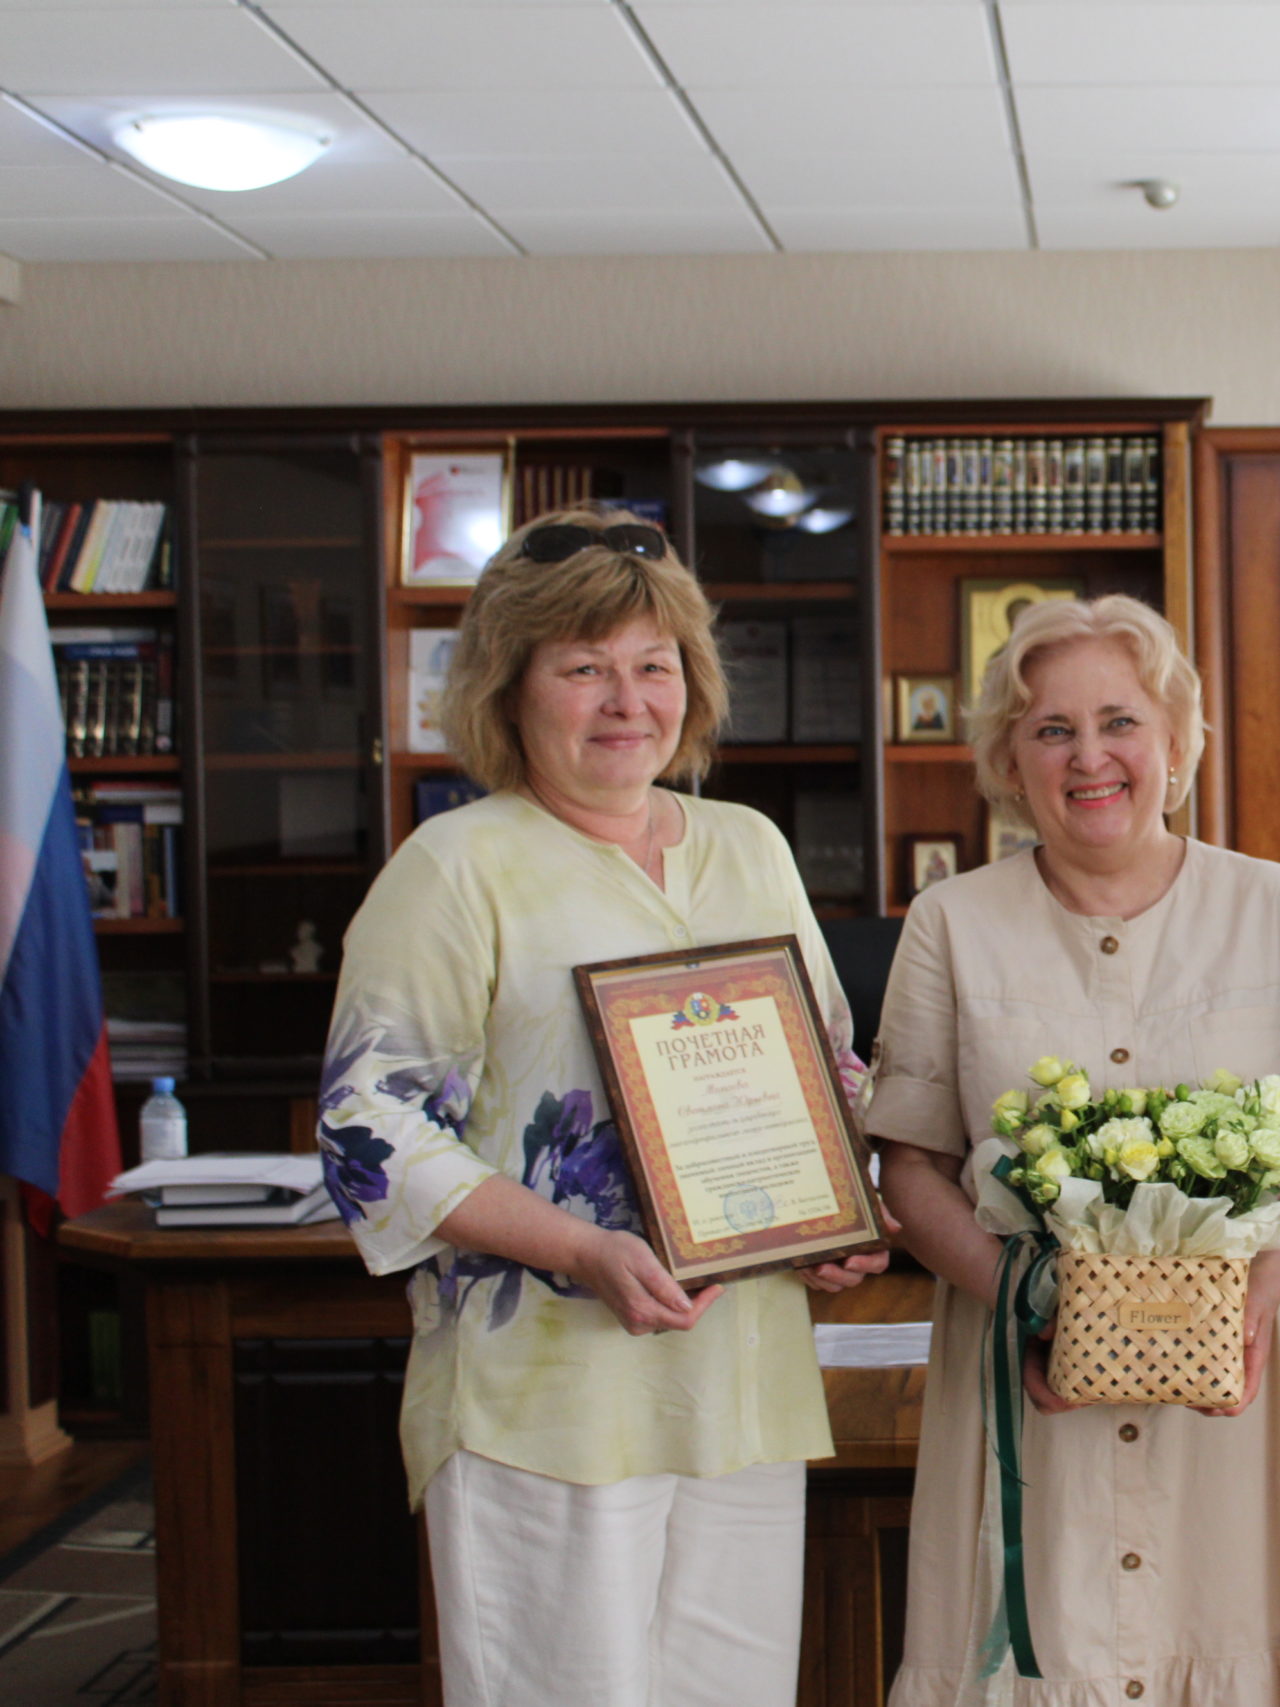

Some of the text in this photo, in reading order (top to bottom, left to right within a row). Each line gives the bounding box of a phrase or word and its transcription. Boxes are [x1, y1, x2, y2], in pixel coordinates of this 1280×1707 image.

[656, 1023, 766, 1057] ПОЧЕТНАЯ
[668, 1042, 765, 1071] ГРАМОТА
[1129, 1310, 1182, 1324] Flower
